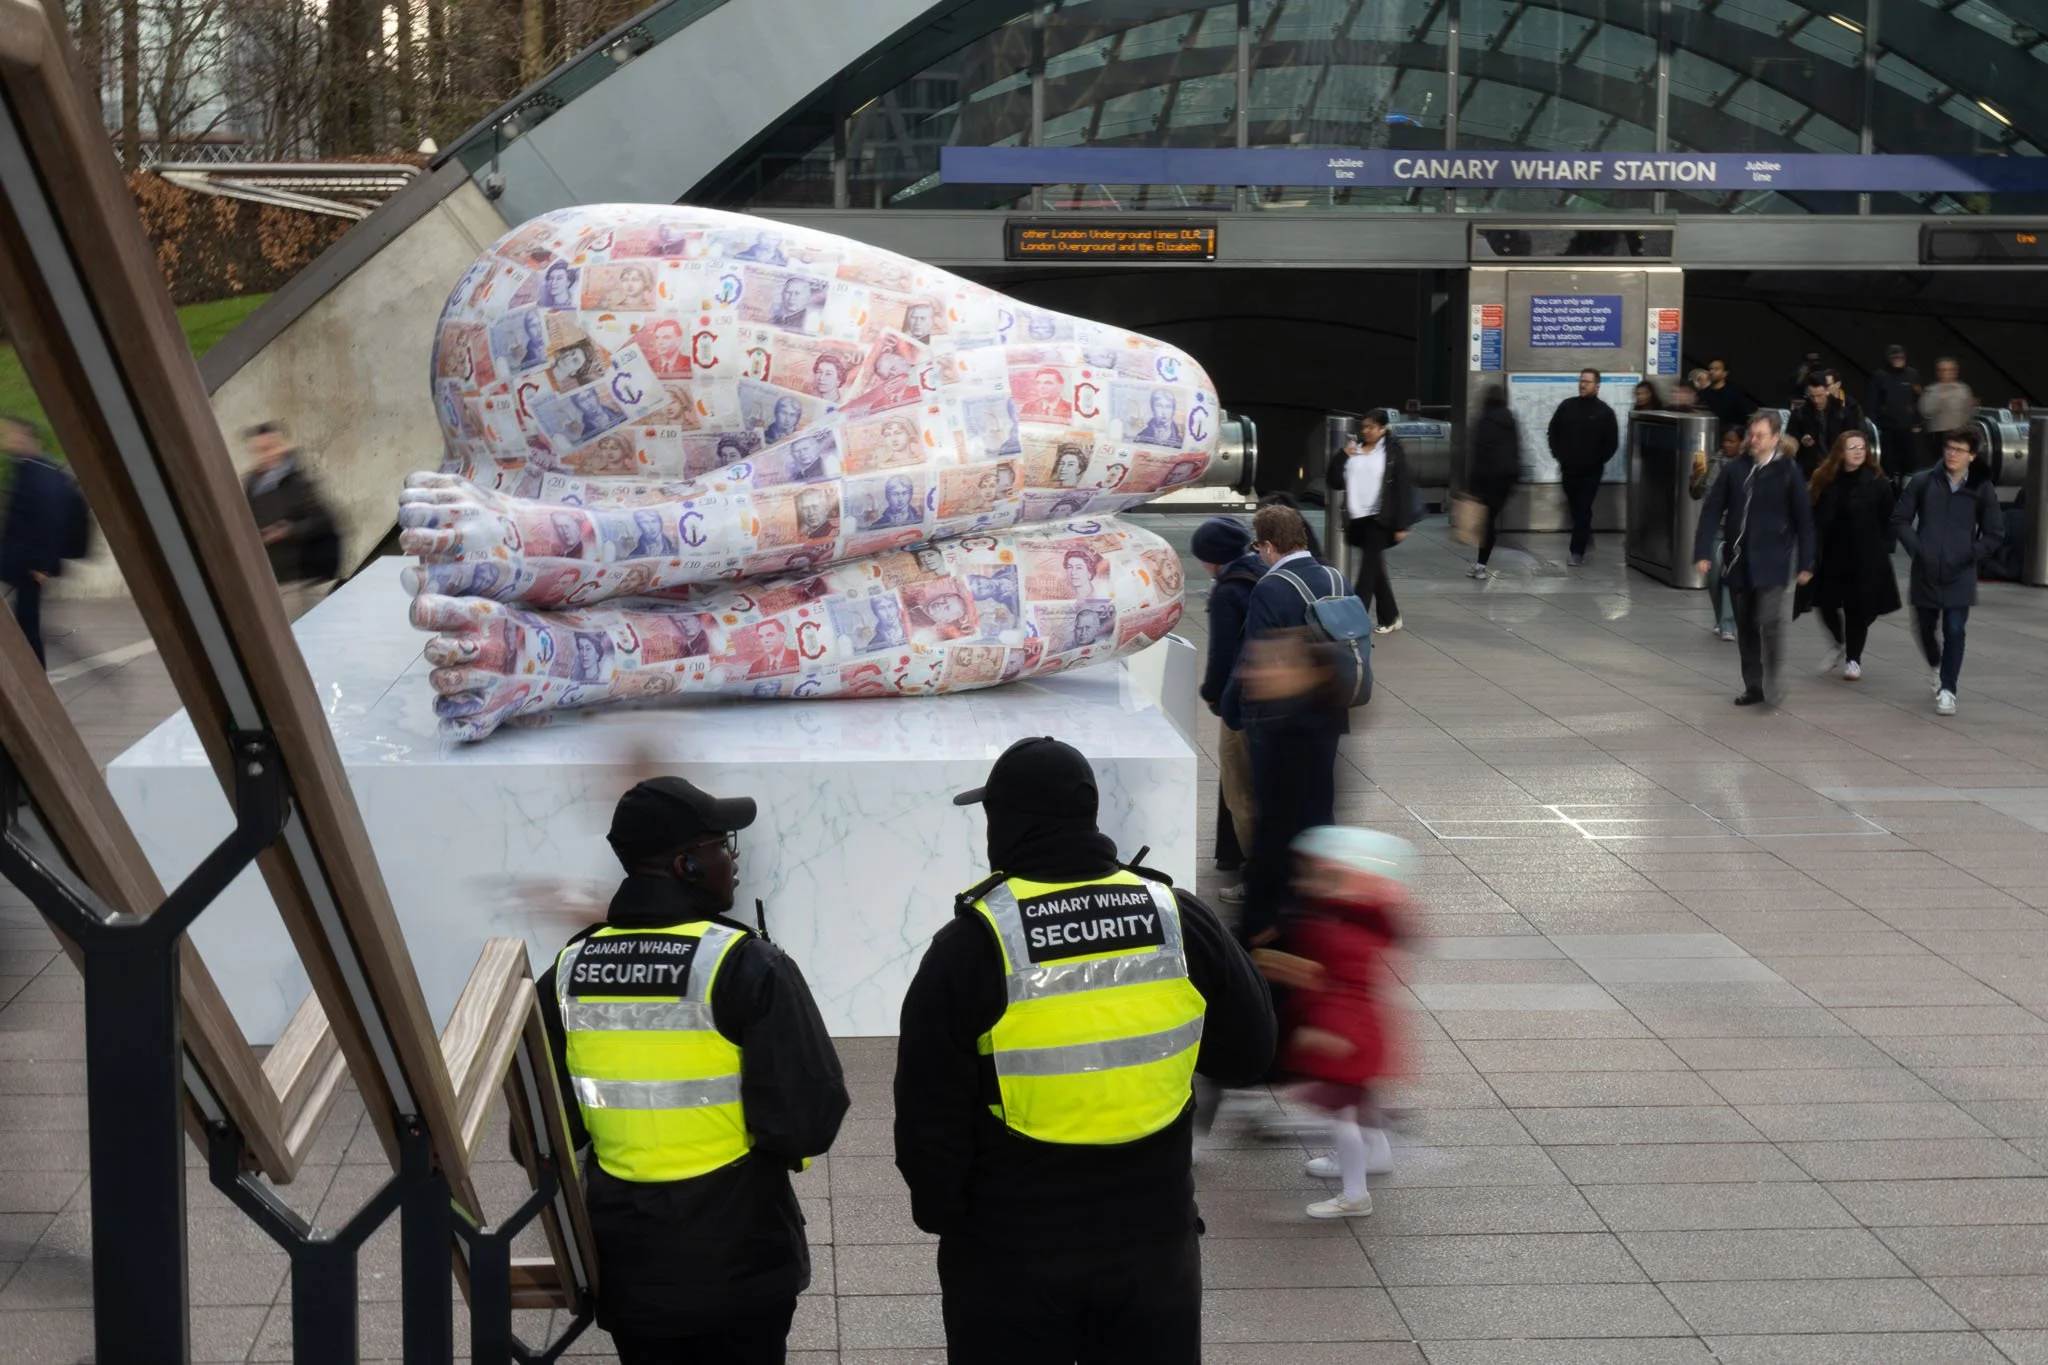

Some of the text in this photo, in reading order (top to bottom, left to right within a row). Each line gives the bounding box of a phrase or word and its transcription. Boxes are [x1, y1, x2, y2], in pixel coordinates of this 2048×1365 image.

[1326, 158, 1364, 168] Jubilee
[1744, 161, 1782, 172] Jubilee
[1335, 169, 1356, 179] line
[1393, 158, 1716, 182] CANARY WHARF STATION
[1752, 171, 1772, 182] line
[1022, 230, 1048, 239] other
[1051, 230, 1087, 239] London
[1089, 230, 1151, 241] Underground
[1153, 230, 1178, 239] lines
[1020, 242, 1202, 253] London Overground and the Elizabeth
[1562, 298, 1579, 306] only
[1562, 324, 1587, 332] Oyster
[660, 430, 677, 438] £10
[683, 561, 701, 570] £10
[1098, 604, 1116, 618] 20
[1023, 643, 1042, 656] 50
[688, 662, 705, 671] £10
[1026, 892, 1149, 918] CANARY WHARF
[1030, 913, 1155, 948] SECURITY
[584, 941, 692, 956] CANARY WHARF
[573, 963, 685, 984] SECURITY
